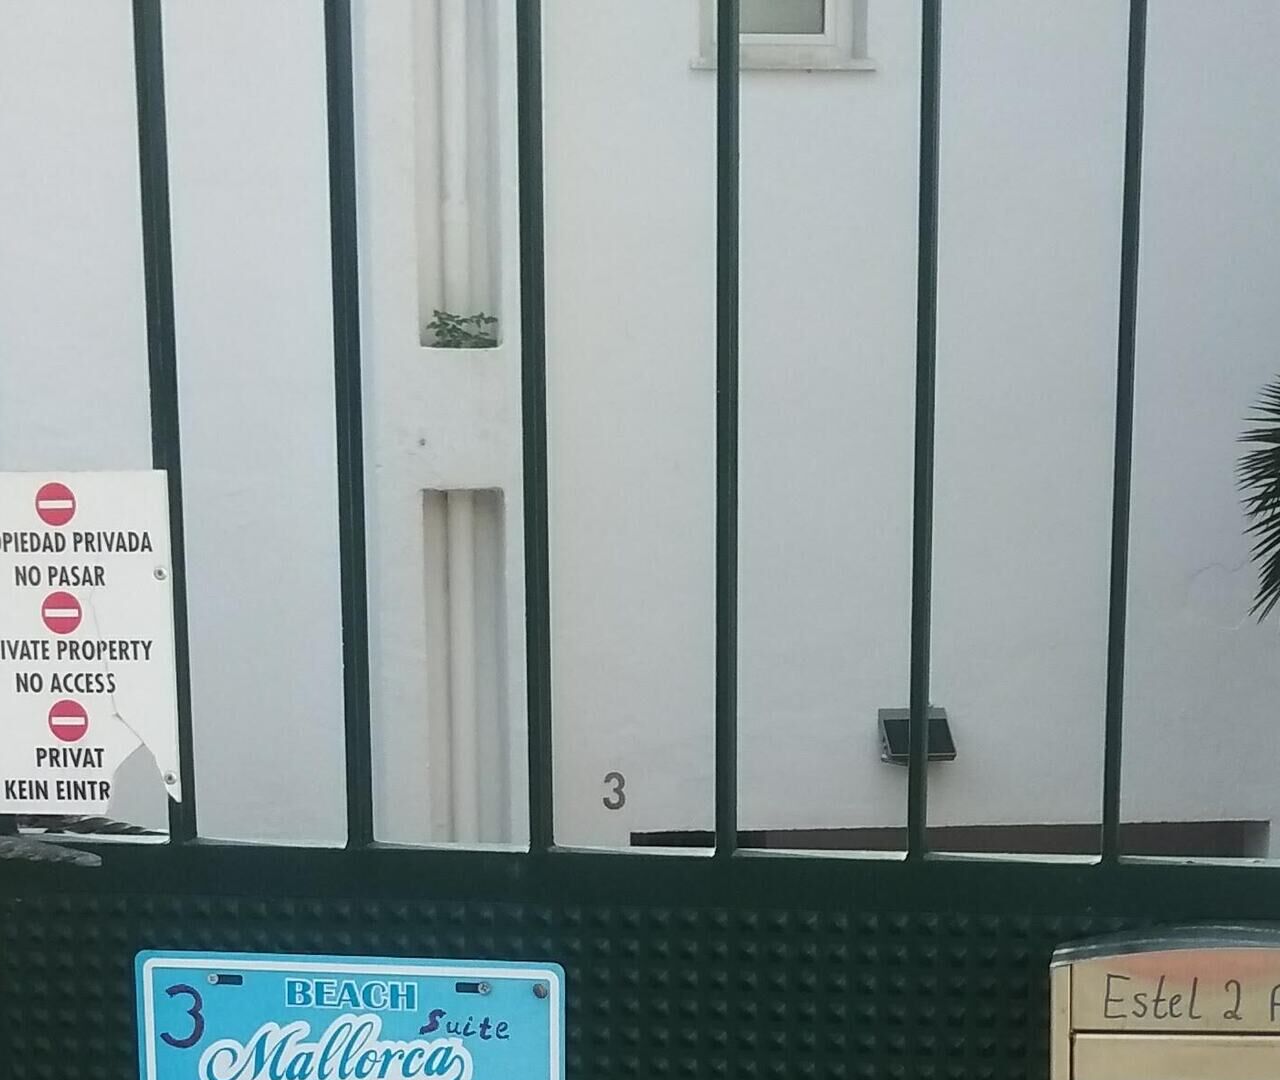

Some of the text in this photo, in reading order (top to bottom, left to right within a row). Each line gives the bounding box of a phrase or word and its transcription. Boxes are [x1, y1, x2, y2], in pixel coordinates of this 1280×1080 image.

[73, 531, 153, 553] PRIVADA
[15, 565, 106, 587] NO PASAR
[57, 639, 153, 661] PROPERTY
[16, 672, 116, 694] NO ACCESS
[36, 747, 105, 768] PRIVAT
[4, 779, 49, 800] KEIN
[602, 771, 626, 810] 3
[285, 977, 418, 1011] BEACH
[1104, 974, 1202, 1020] Estel
[1223, 979, 1243, 1021] 2
[160, 983, 205, 1049] 3
[419, 1008, 510, 1041] Suite
